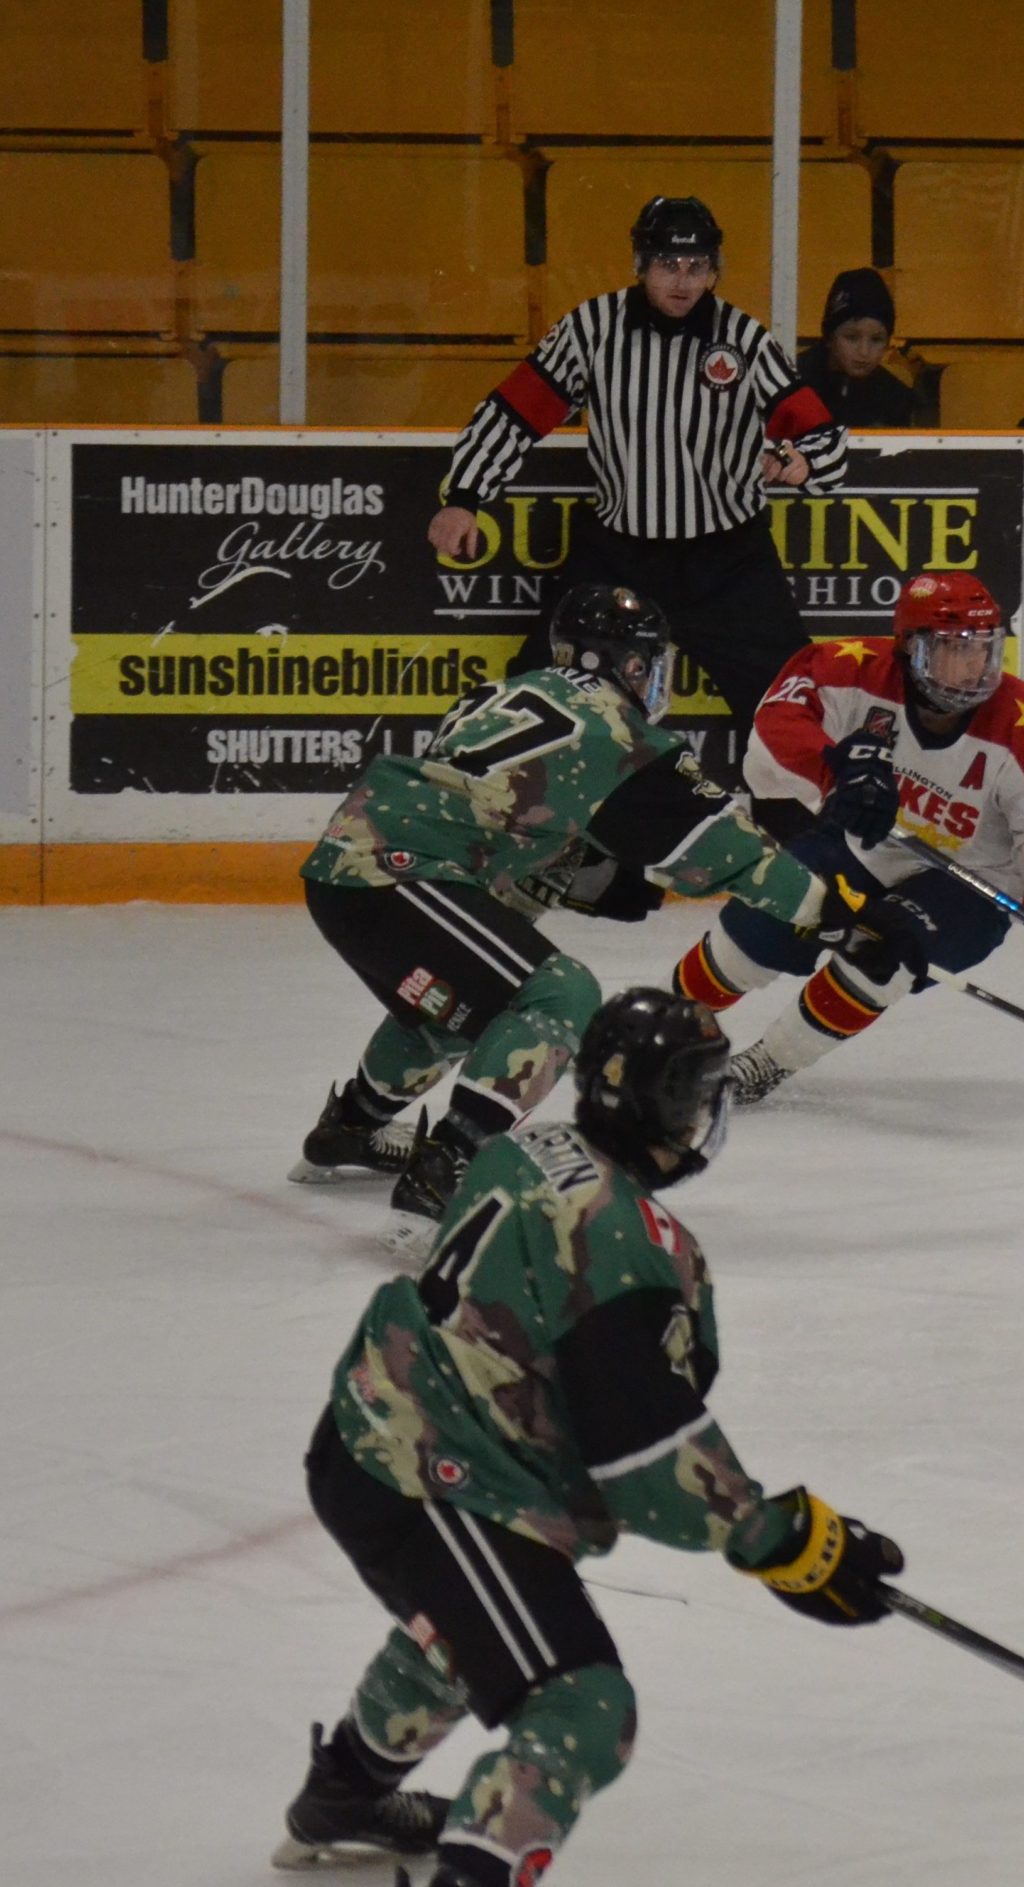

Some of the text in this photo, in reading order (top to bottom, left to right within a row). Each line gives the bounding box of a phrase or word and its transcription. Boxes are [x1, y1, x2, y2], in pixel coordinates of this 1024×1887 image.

[121, 476, 385, 519] HunterDouglas
[197, 521, 387, 592] Gallery
[206, 728, 363, 764] SHUTTERS
[894, 766, 954, 799] LLINGTON
[958, 751, 988, 790] A
[397, 967, 434, 1006] Pita
[419, 984, 449, 1016] Pit
